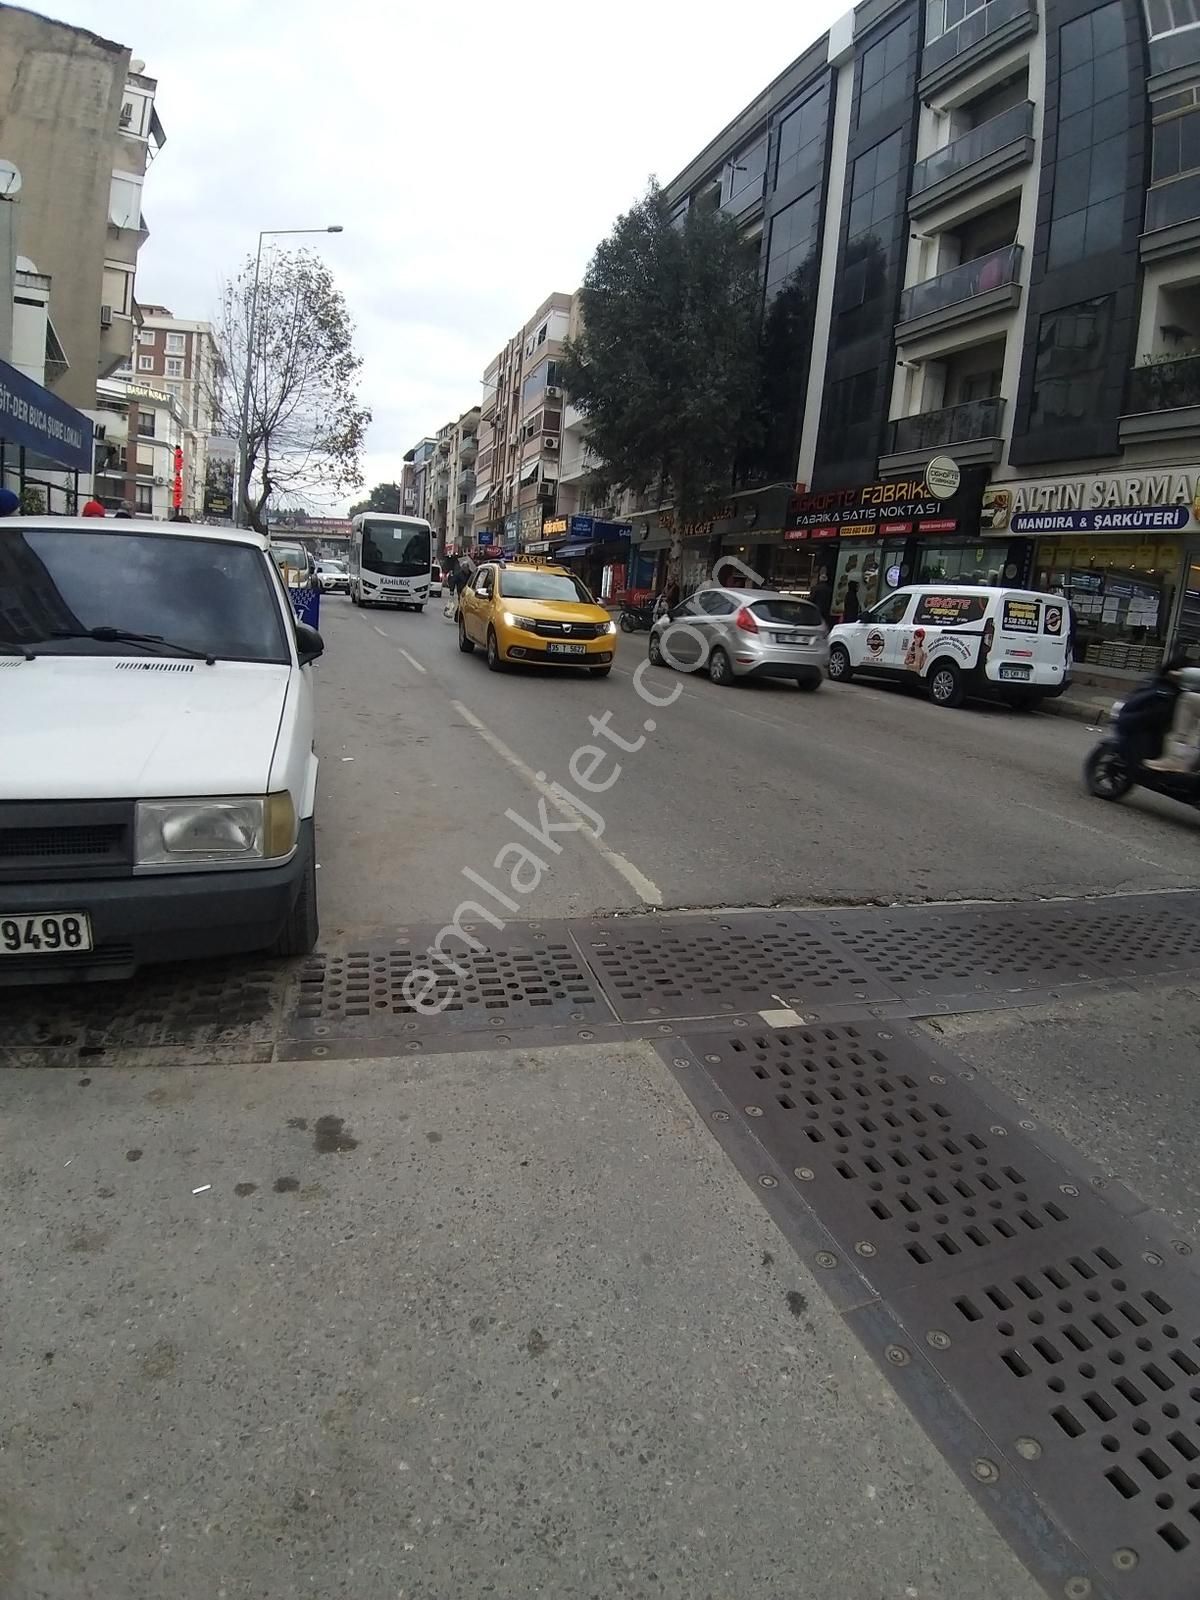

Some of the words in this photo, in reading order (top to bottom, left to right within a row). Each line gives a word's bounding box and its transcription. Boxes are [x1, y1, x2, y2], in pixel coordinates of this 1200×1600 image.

[29, 405, 47, 432] BUCA
[47, 415, 64, 439] ŞUBE
[1012, 483, 1083, 513] ALTIN
[1091, 475, 1193, 509] SARMA
[842, 507, 876, 522] SATIŞ
[879, 502, 941, 518] NOKTASI
[1017, 516, 1074, 530] MANDIRA
[1079, 517, 1087, 527] &
[1094, 509, 1179, 530] ŞARKÜTERİ
[1, 917, 82, 951] 9498
